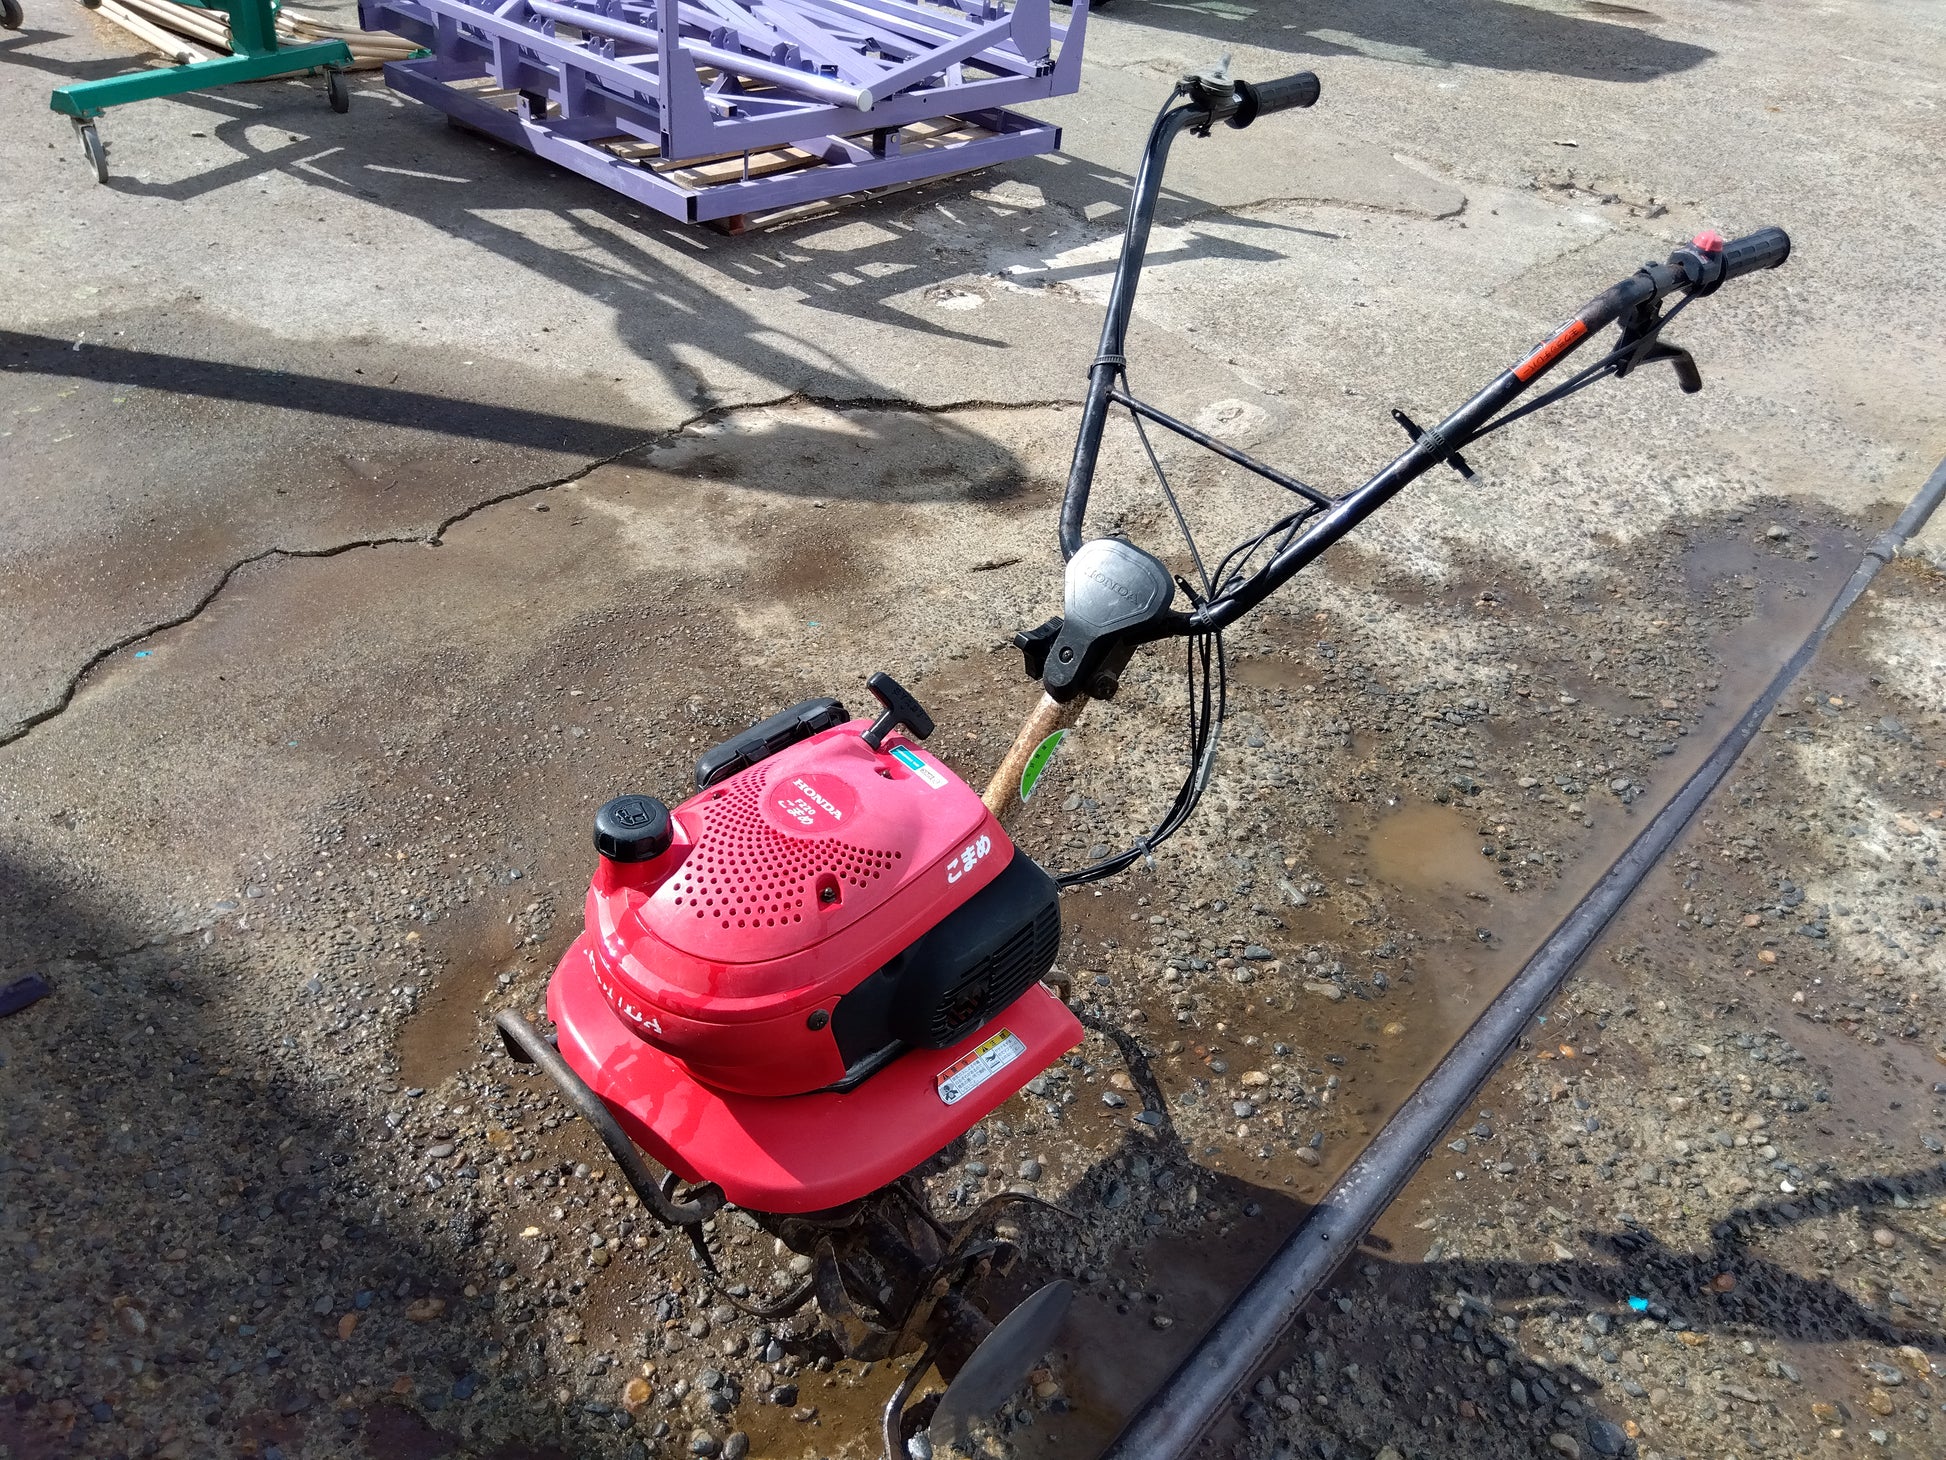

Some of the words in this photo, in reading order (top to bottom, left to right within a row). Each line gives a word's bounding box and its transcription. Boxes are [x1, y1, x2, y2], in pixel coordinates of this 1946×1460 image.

[1523, 328, 1579, 374] 主クラッチレバー
[778, 800, 814, 825] こまめ
[792, 778, 843, 821] HONDA
[795, 798, 817, 815] F220
[947, 835, 991, 884] こまめ
